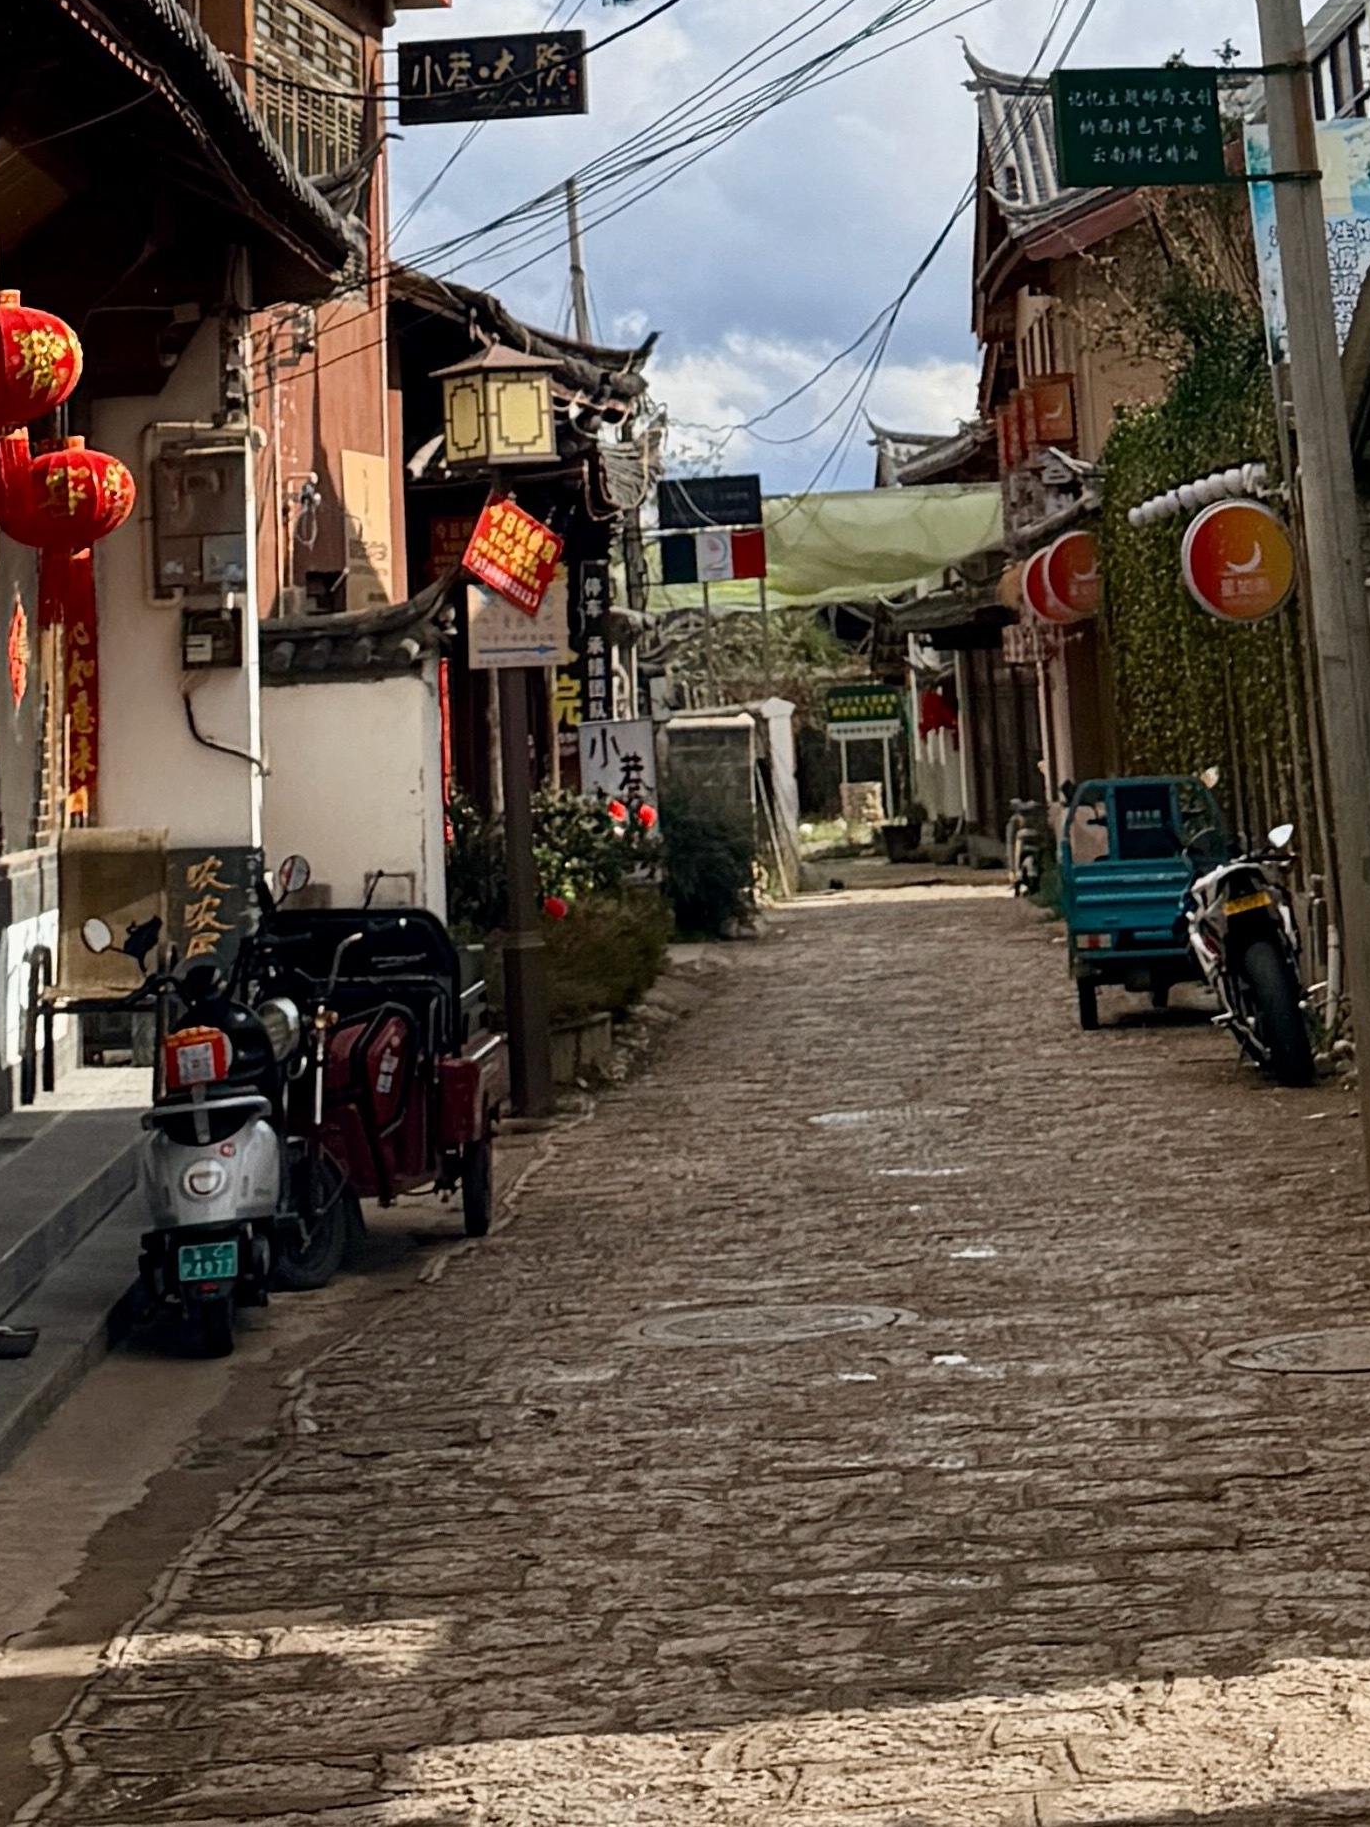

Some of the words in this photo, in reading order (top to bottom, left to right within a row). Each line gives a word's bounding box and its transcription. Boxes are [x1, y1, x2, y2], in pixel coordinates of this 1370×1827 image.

[1092, 143, 1199, 164] 云南鲜花精油
[585, 577, 603, 618] 停车
